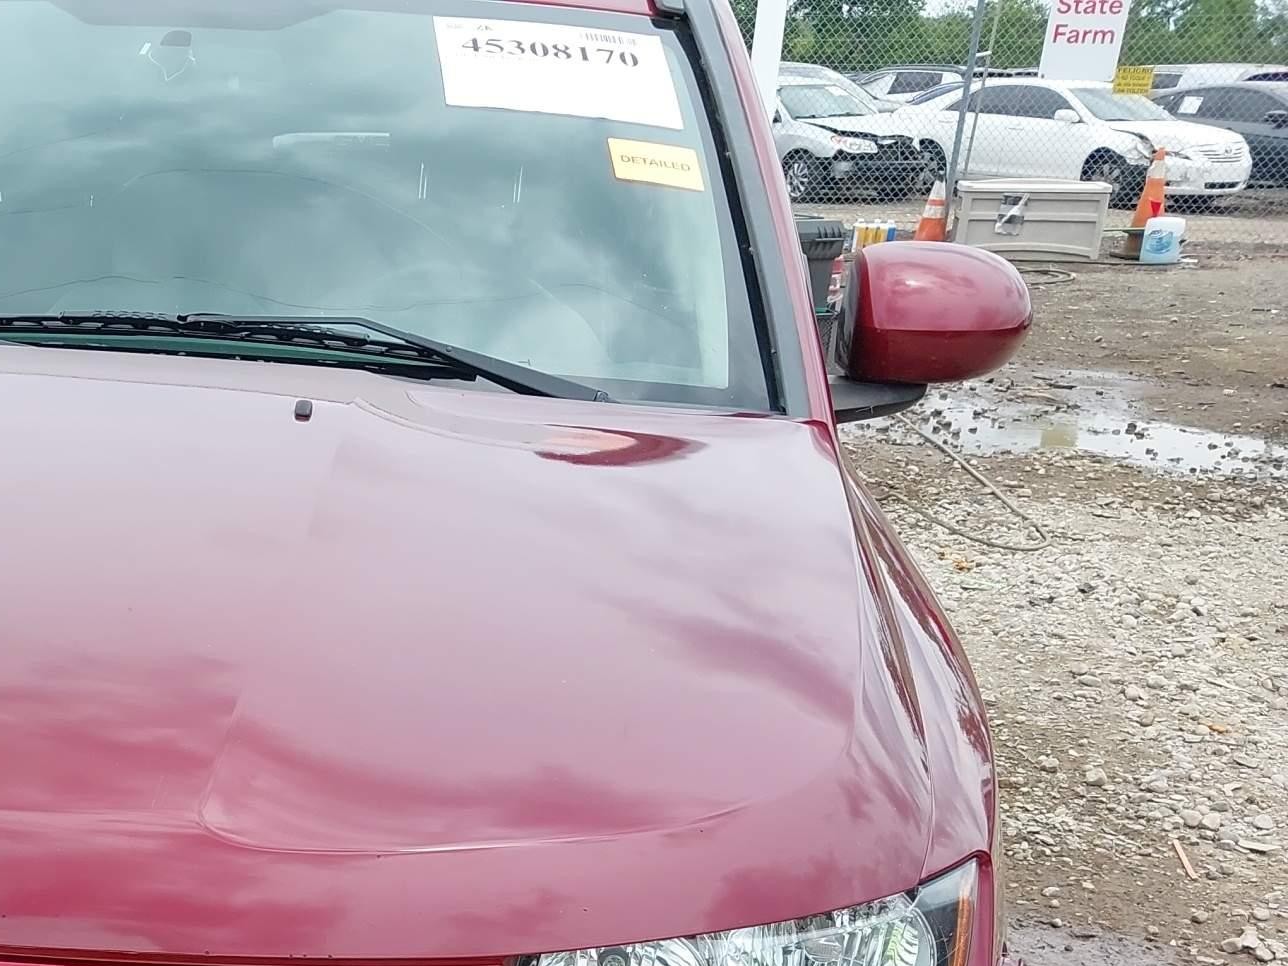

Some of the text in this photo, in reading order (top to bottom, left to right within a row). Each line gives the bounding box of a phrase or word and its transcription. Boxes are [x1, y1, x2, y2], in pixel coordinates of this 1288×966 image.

[1057, 0, 1123, 14] State
[1053, 24, 1115, 44] Farm
[462, 37, 639, 67] 45308170
[620, 154, 691, 172] DETAILED
